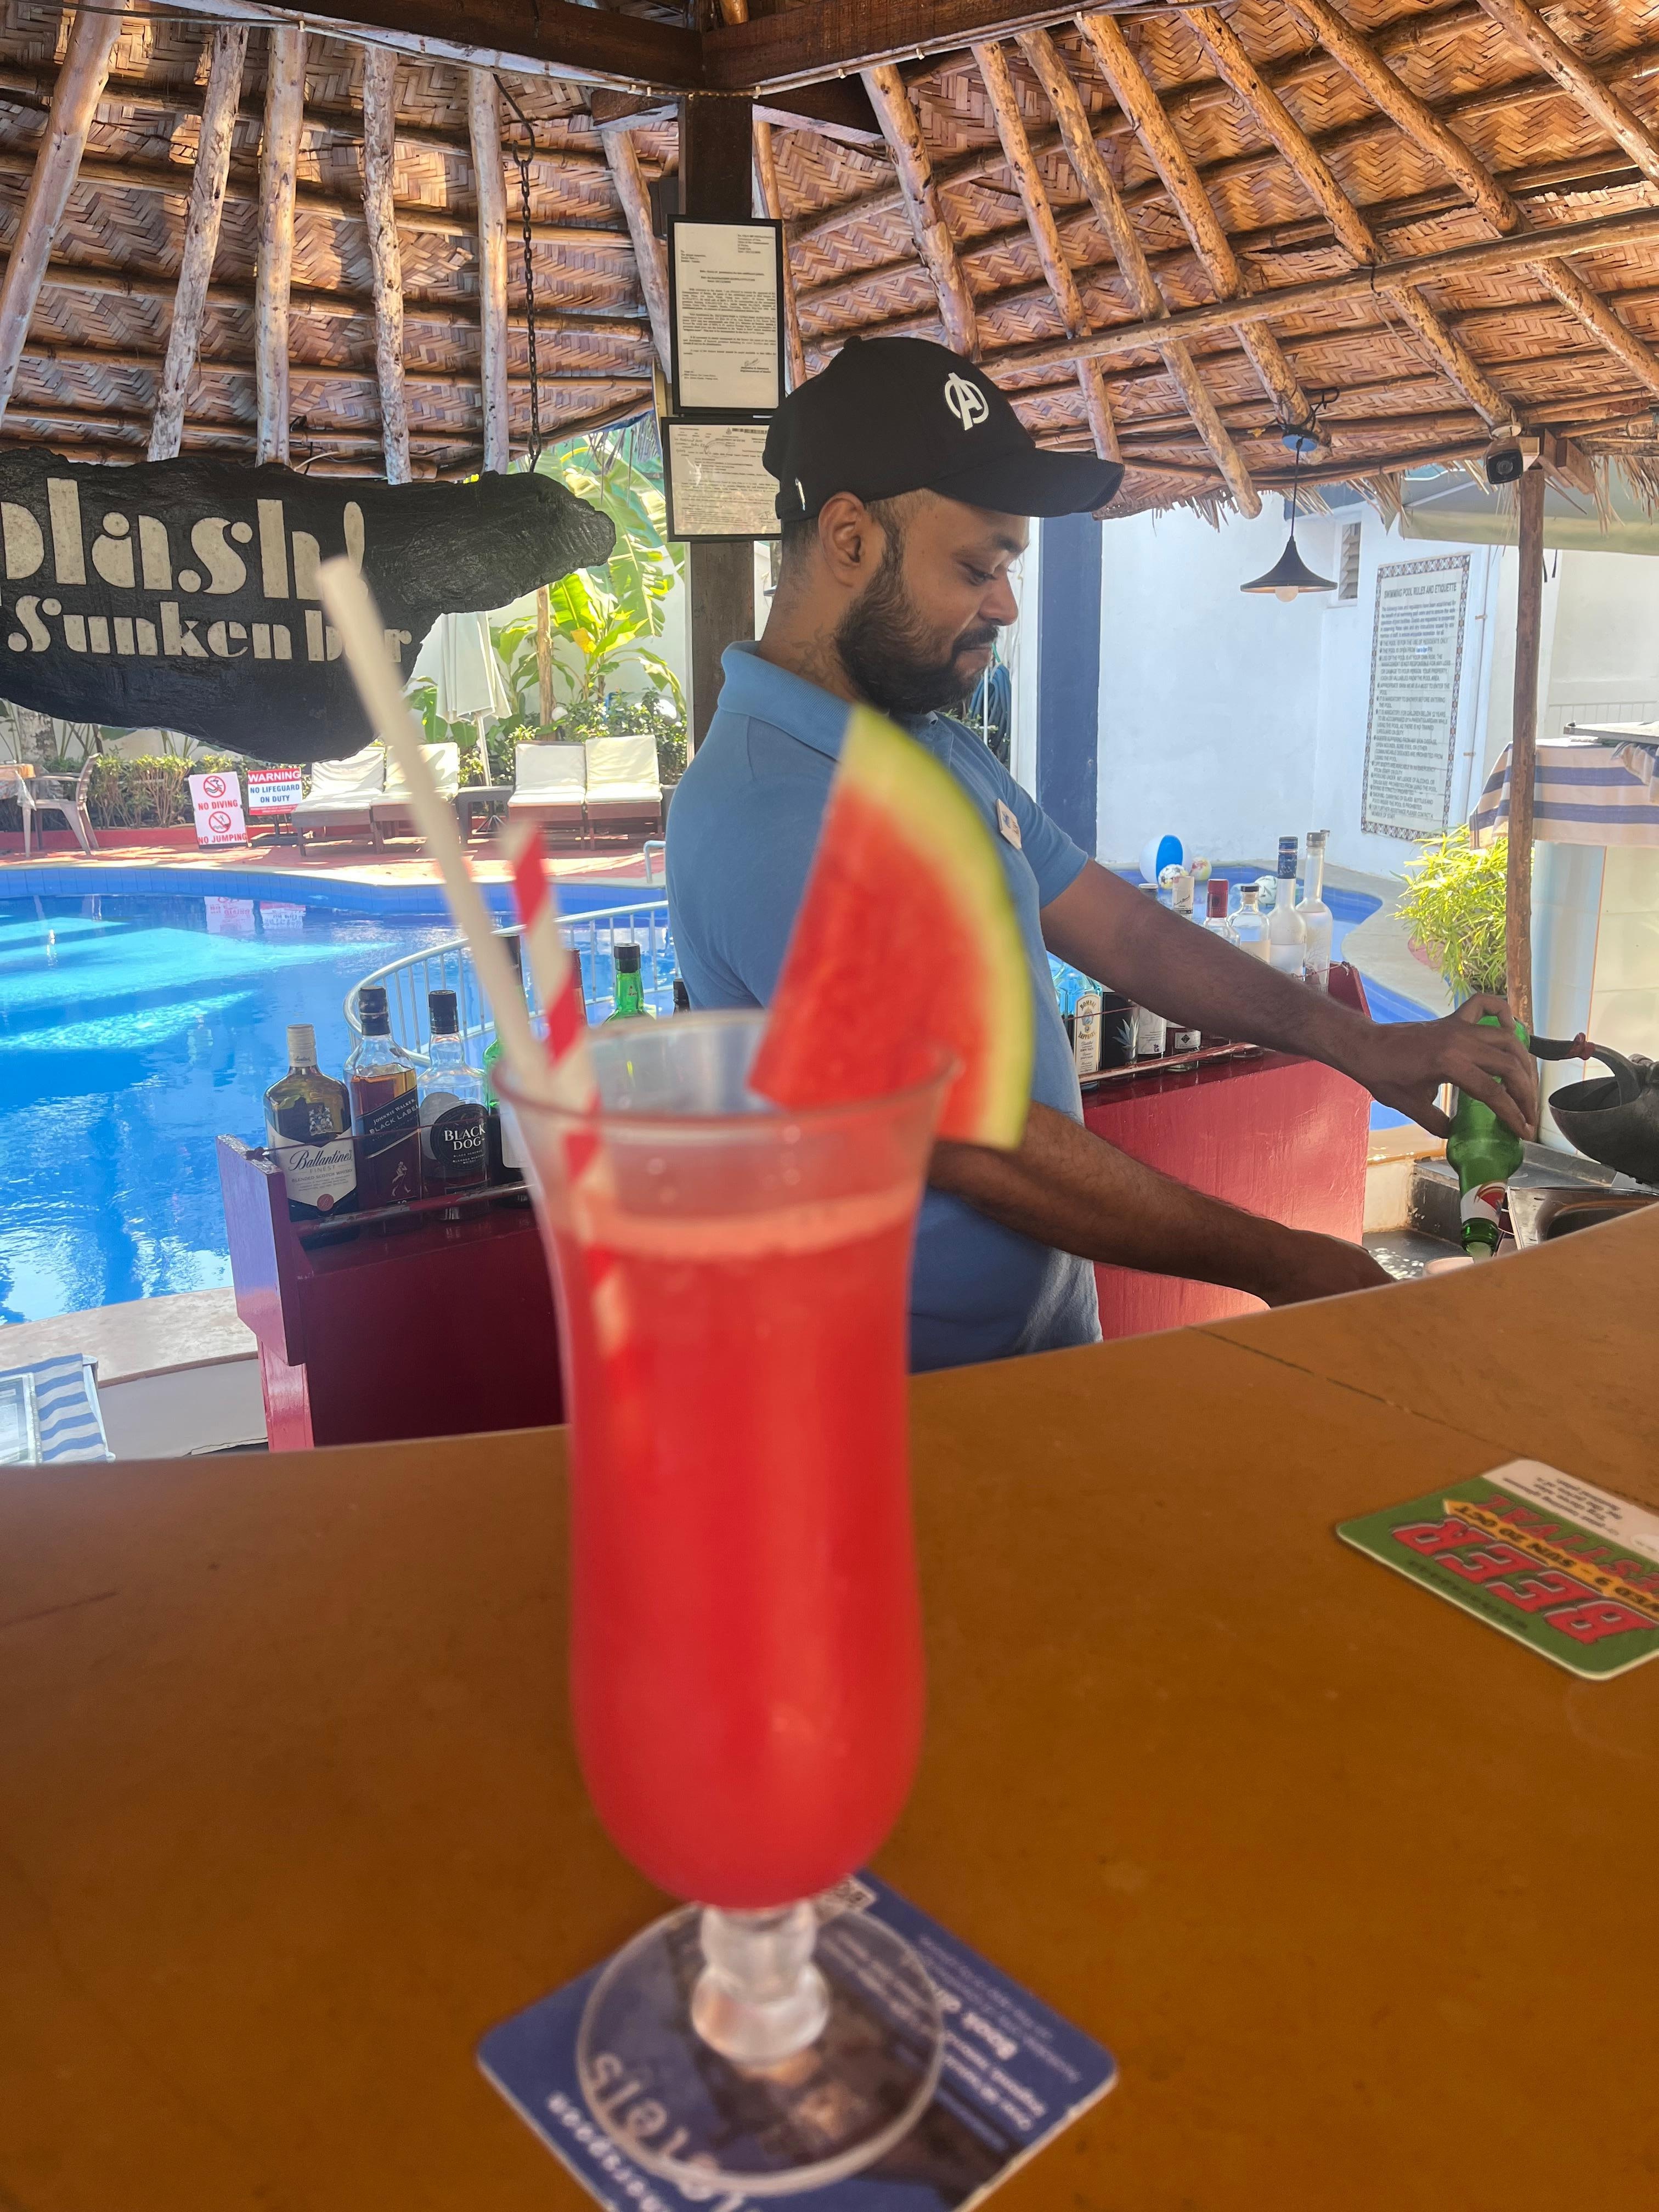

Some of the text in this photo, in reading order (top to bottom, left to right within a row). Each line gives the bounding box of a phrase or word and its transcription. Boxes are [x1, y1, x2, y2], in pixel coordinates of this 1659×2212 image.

[1403, 588, 1413, 597] POOL
[1413, 586, 1425, 596] RULES
[8, 595, 411, 663] Sunken br
[248, 770, 301, 782] WARNING
[262, 783, 300, 793] LIFEGUARD
[198, 800, 238, 811] NO DIVING
[198, 833, 247, 844] NO JUMPING
[369, 1118, 396, 1134] BLACK
[444, 1124, 486, 1141] BLACK
[309, 1165, 336, 1173] FINEST
[1391, 1517, 1659, 1645] BEER
